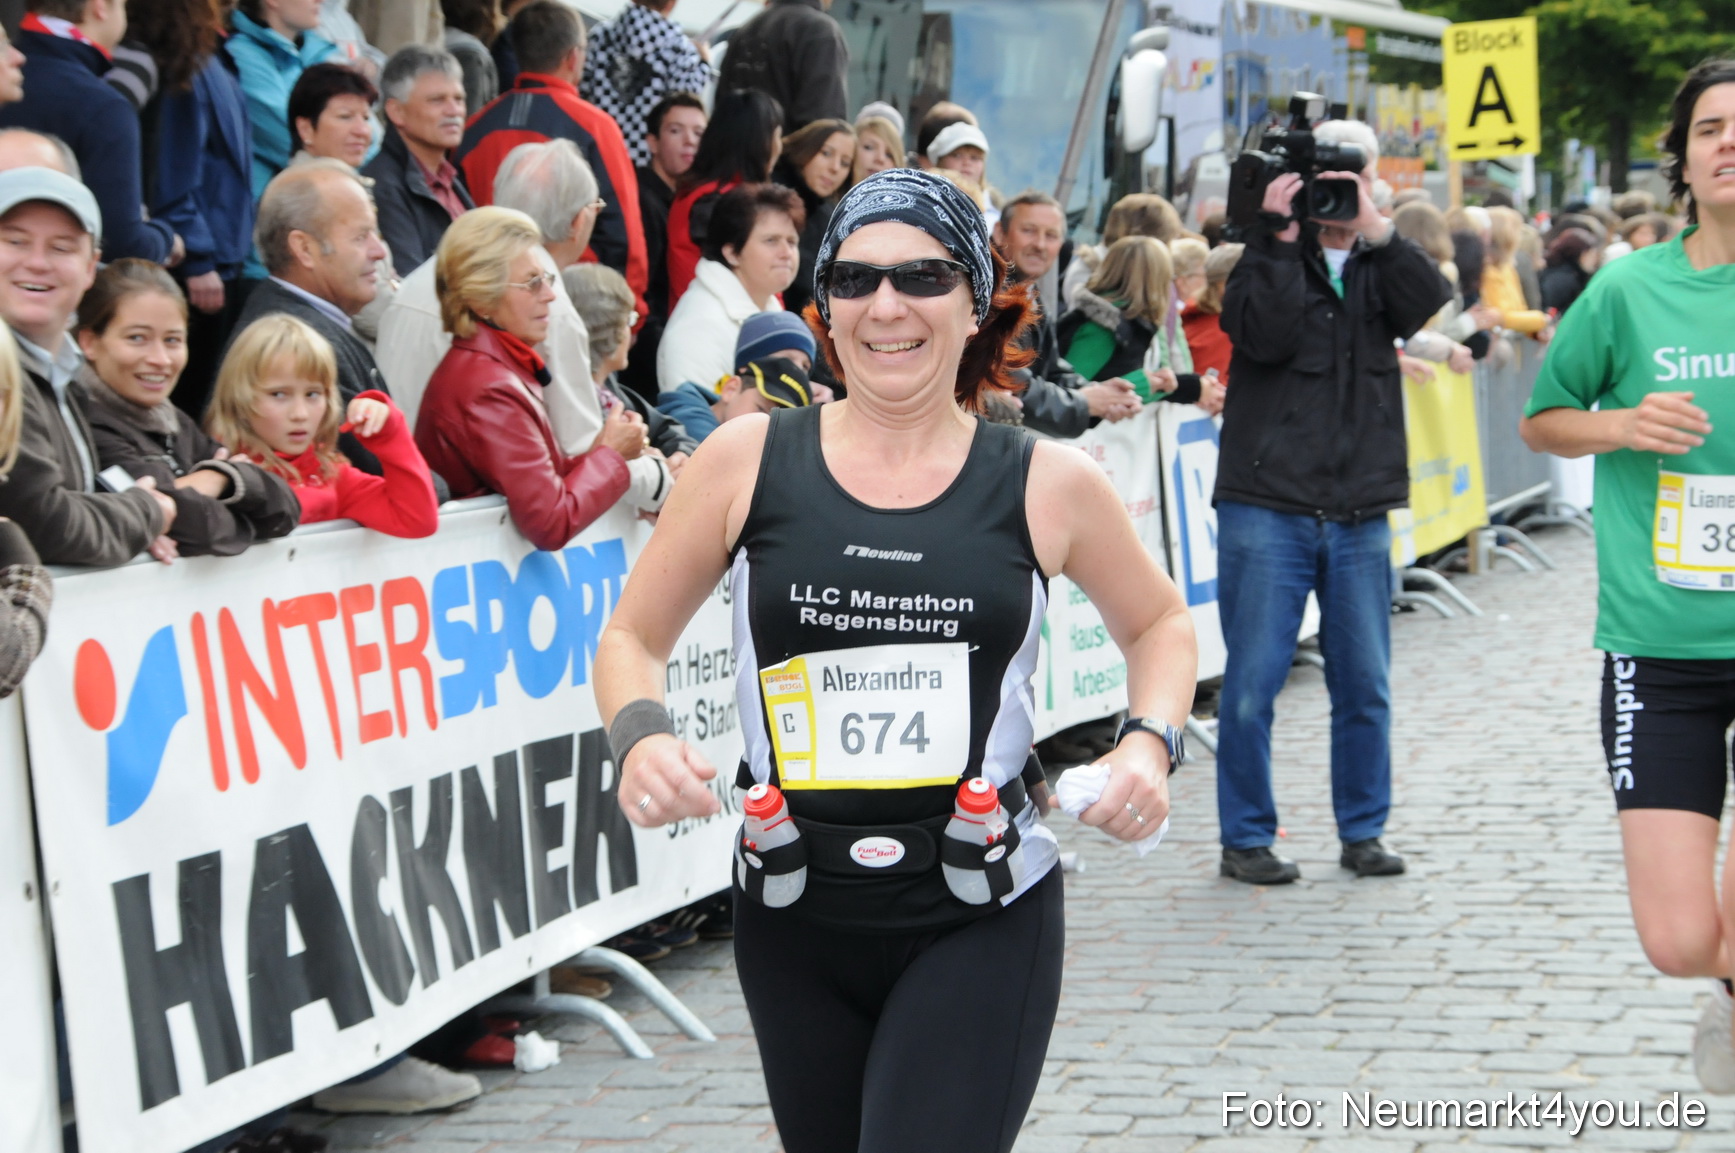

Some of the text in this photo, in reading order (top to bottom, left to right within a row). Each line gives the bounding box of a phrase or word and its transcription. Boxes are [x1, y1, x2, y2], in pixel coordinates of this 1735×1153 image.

[1454, 27, 1525, 54] Block
[1469, 65, 1514, 127] A
[790, 583, 974, 612] LLC Marathon
[800, 607, 959, 637] Regensburg
[190, 537, 627, 792] INTERSPORT
[822, 661, 943, 692] Alexandra
[782, 713, 796, 733] C
[840, 711, 931, 755] 674
[111, 728, 639, 1114] HACKNER
